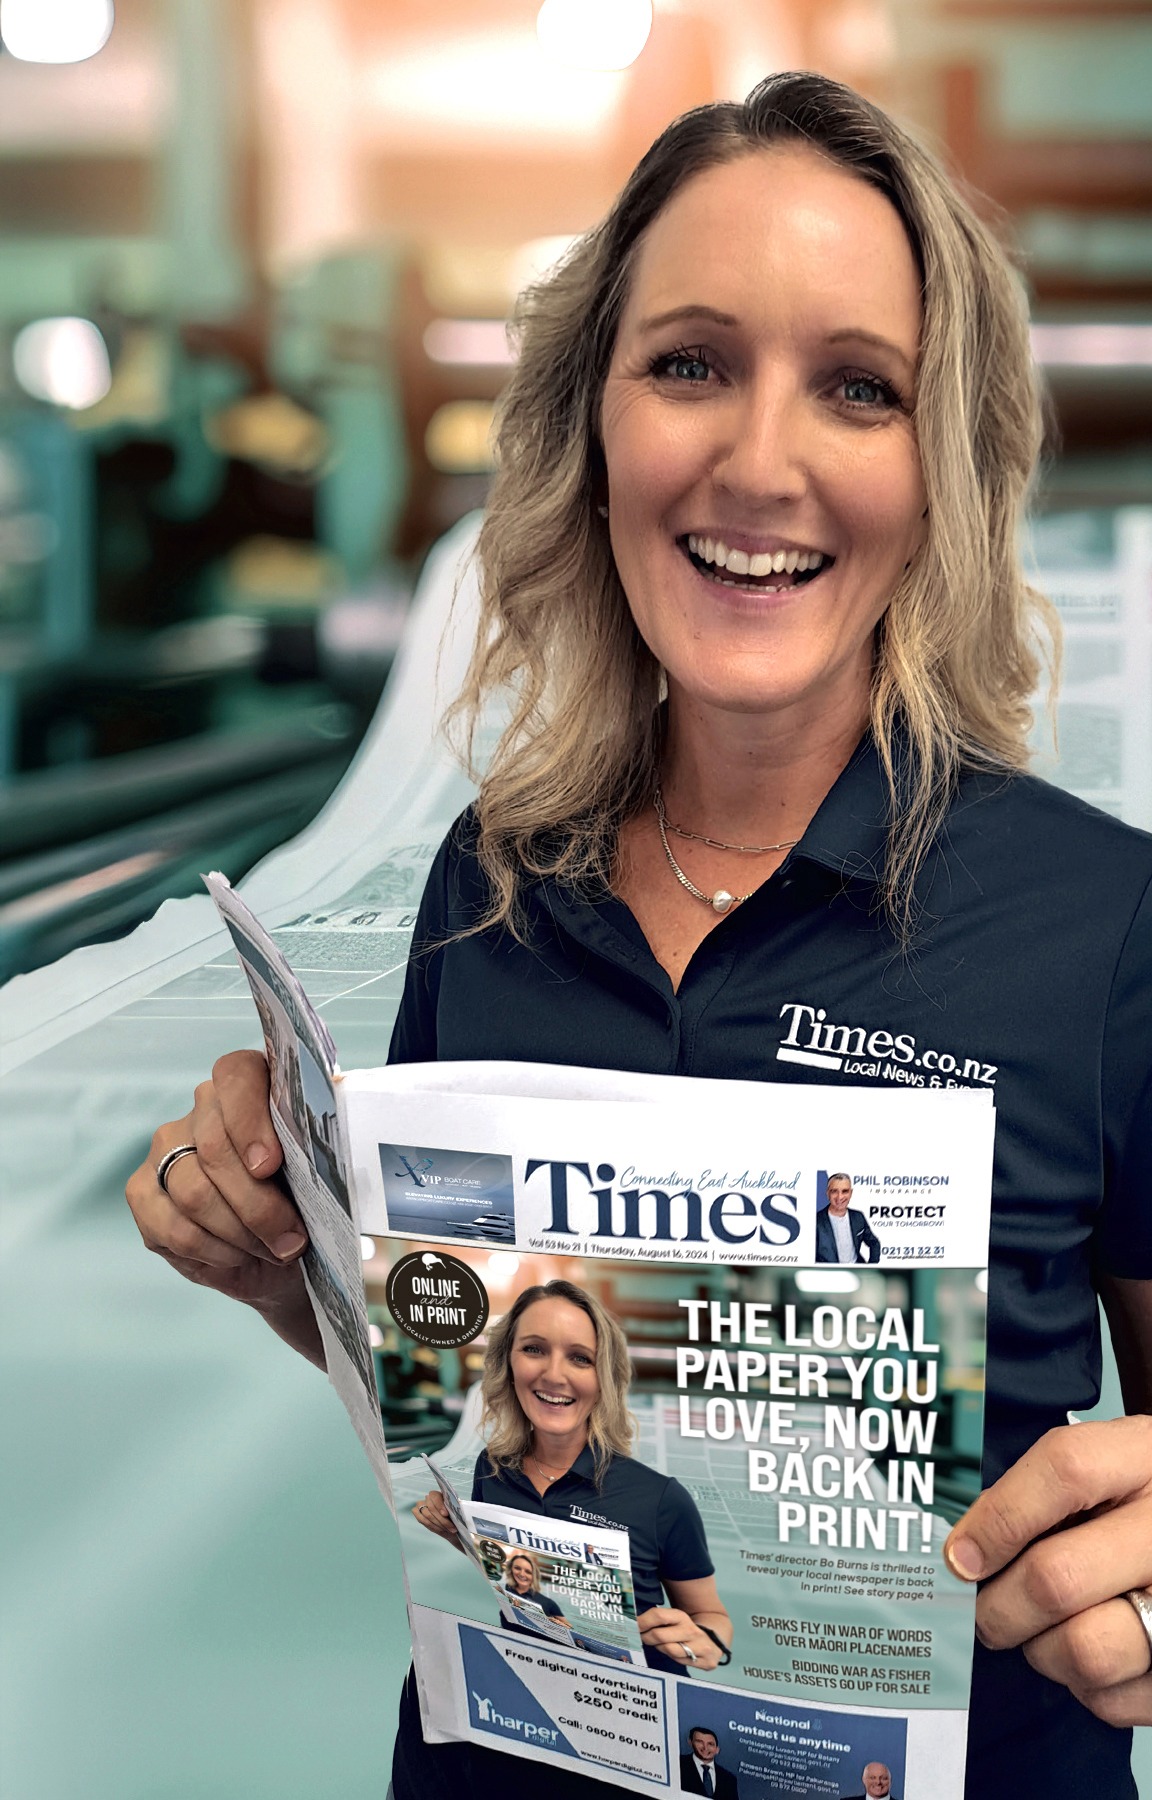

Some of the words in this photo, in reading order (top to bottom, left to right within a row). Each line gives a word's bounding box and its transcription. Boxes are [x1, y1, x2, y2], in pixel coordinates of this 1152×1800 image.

[779, 1003, 998, 1084] Times.co.nz
[844, 1059, 881, 1078] Local
[882, 1063, 925, 1088] News
[929, 1074, 943, 1089] &
[421, 1174, 441, 1184] VIP
[444, 1176, 461, 1184] BOAT
[462, 1178, 481, 1186] CARE
[619, 1166, 694, 1199] Connecting
[697, 1169, 728, 1191] East
[728, 1170, 801, 1190] Auckland
[853, 1175, 880, 1186] PHIL
[883, 1176, 949, 1186] ROBINSON
[524, 1159, 801, 1246] Times
[869, 1205, 946, 1218] PROTECT
[529, 1238, 543, 1248] Vol
[557, 1240, 570, 1250] No
[591, 1243, 636, 1258] Thursday,
[638, 1247, 671, 1259] August
[685, 1250, 708, 1260] 2024
[719, 1252, 799, 1263] www.times.co.nz
[881, 1246, 901, 1255] 021
[412, 1277, 461, 1298] ONLINE
[420, 1295, 453, 1306] and
[393, 1308, 404, 1323] 100%
[403, 1323, 429, 1342] LOCALLY
[462, 1314, 484, 1340] OPERATED
[409, 1304, 424, 1322] IN
[427, 1306, 467, 1326] PRINT
[678, 1299, 773, 1345] THE
[785, 1304, 940, 1353] LOCAL
[676, 1346, 829, 1398] PAPER
[841, 1355, 938, 1404] YOU
[679, 1395, 811, 1453] LOVE,
[824, 1404, 938, 1454] NOW
[749, 1449, 875, 1501] BACK
[888, 1459, 935, 1505] IN
[570, 1504, 629, 1531] Times.co.nz
[778, 1501, 933, 1553] PRINT!
[509, 1526, 582, 1558] Times
[552, 1564, 576, 1578] THE
[579, 1569, 620, 1585] LOCAL
[746, 1564, 779, 1575] reveal
[781, 1569, 805, 1578] your
[806, 1570, 832, 1581] local
[834, 1573, 893, 1587] newspaper
[895, 1576, 905, 1586] is
[907, 1576, 935, 1588] back
[775, 1553, 818, 1567] director
[820, 1558, 834, 1568] Bo
[837, 1559, 869, 1571] Burns
[871, 1561, 881, 1572] is
[882, 1562, 922, 1575] thrilled
[924, 1565, 935, 1575] to
[551, 1575, 591, 1590] PAPER
[595, 1582, 621, 1594] YOU
[812, 1583, 841, 1594] print!
[844, 1585, 864, 1596] See
[866, 1588, 895, 1600] story
[896, 1591, 924, 1601] page
[926, 1591, 934, 1600] 4
[571, 1597, 606, 1611] BACK
[608, 1604, 623, 1614] IN
[591, 1591, 622, 1604] NOW
[580, 1608, 625, 1623] PRINT!
[751, 1615, 798, 1633] SPARKS
[800, 1621, 822, 1635] FLY
[824, 1623, 836, 1636] IN
[838, 1624, 866, 1639] WAR
[868, 1627, 884, 1640] OF
[887, 1629, 932, 1643] WORDS
[775, 1633, 807, 1648] OVER
[809, 1636, 847, 1653] MĀORI
[850, 1641, 932, 1658] PLACENAMES
[505, 1648, 533, 1663] Free
[536, 1658, 578, 1677] digital
[581, 1671, 657, 1700] advertising
[743, 1666, 792, 1683] HOUSE'S
[794, 1673, 837, 1689] ASSETS
[839, 1678, 855, 1691] GO
[857, 1679, 873, 1692] UP
[875, 1681, 898, 1694] FOR
[900, 1682, 931, 1695] SALE
[792, 1659, 839, 1675] BIDDING
[841, 1665, 868, 1678] WAR
[870, 1667, 886, 1679] AS
[888, 1668, 931, 1681] FISHER
[573, 1690, 613, 1711] $250
[618, 1706, 659, 1724] credit
[593, 1684, 629, 1702] audit
[632, 1695, 658, 1709] and
[491, 1708, 559, 1741] harper
[755, 1710, 810, 1730] National
[558, 1715, 583, 1730] Call:
[586, 1725, 615, 1740] 0800
[641, 1741, 661, 1753] 061
[728, 1720, 778, 1740] Contact
[780, 1733, 797, 1743] us
[798, 1737, 851, 1753] anytime
